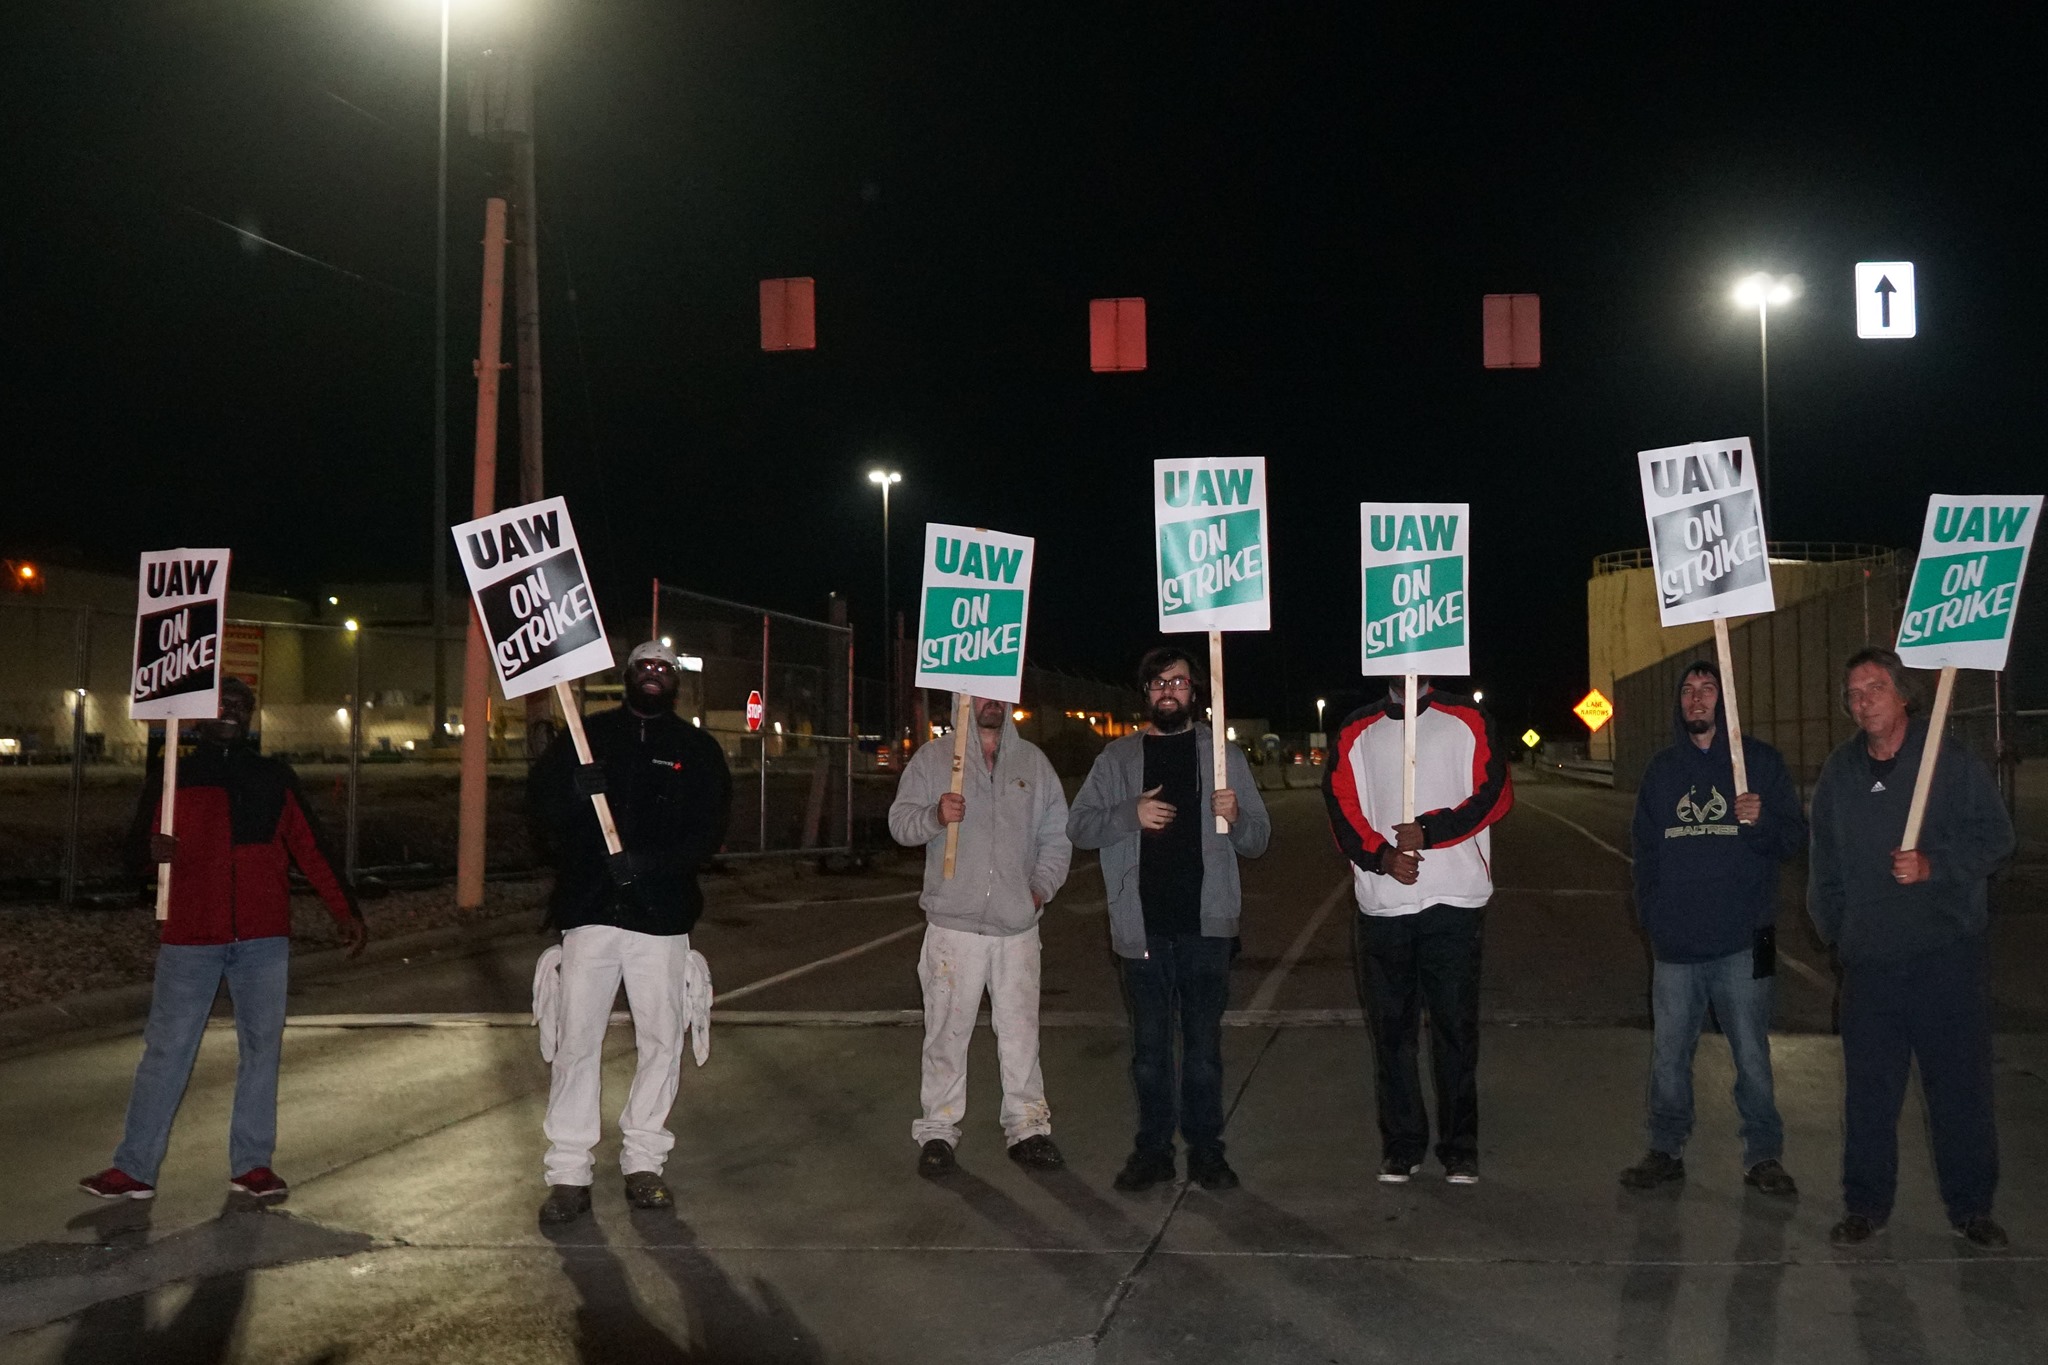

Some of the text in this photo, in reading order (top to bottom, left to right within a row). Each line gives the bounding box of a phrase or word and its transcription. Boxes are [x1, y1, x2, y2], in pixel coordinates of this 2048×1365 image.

[1164, 468, 1253, 508] UAW
[1650, 449, 1742, 498] UAW
[466, 510, 561, 570] UAW
[1188, 518, 1227, 563] ON
[1370, 515, 1459, 551] UAW
[1683, 503, 1723, 551] ON
[1933, 506, 2030, 543] UAW
[147, 560, 218, 598] UAW
[935, 536, 1024, 584] UAW
[1162, 544, 1262, 612] STRIKE
[1662, 525, 1762, 604] STRIKE
[1941, 555, 1988, 596] ON
[509, 567, 551, 619] ON
[1392, 564, 1431, 606] ON
[159, 608, 189, 651] ON
[497, 582, 593, 676] STRIKE
[951, 593, 990, 629] ON
[1366, 590, 1463, 655] STRIKE
[1901, 582, 2016, 643] STRIKE
[135, 633, 217, 699] STRIKE
[922, 623, 1021, 669] STRIKE
[747, 703, 762, 719] STOP
